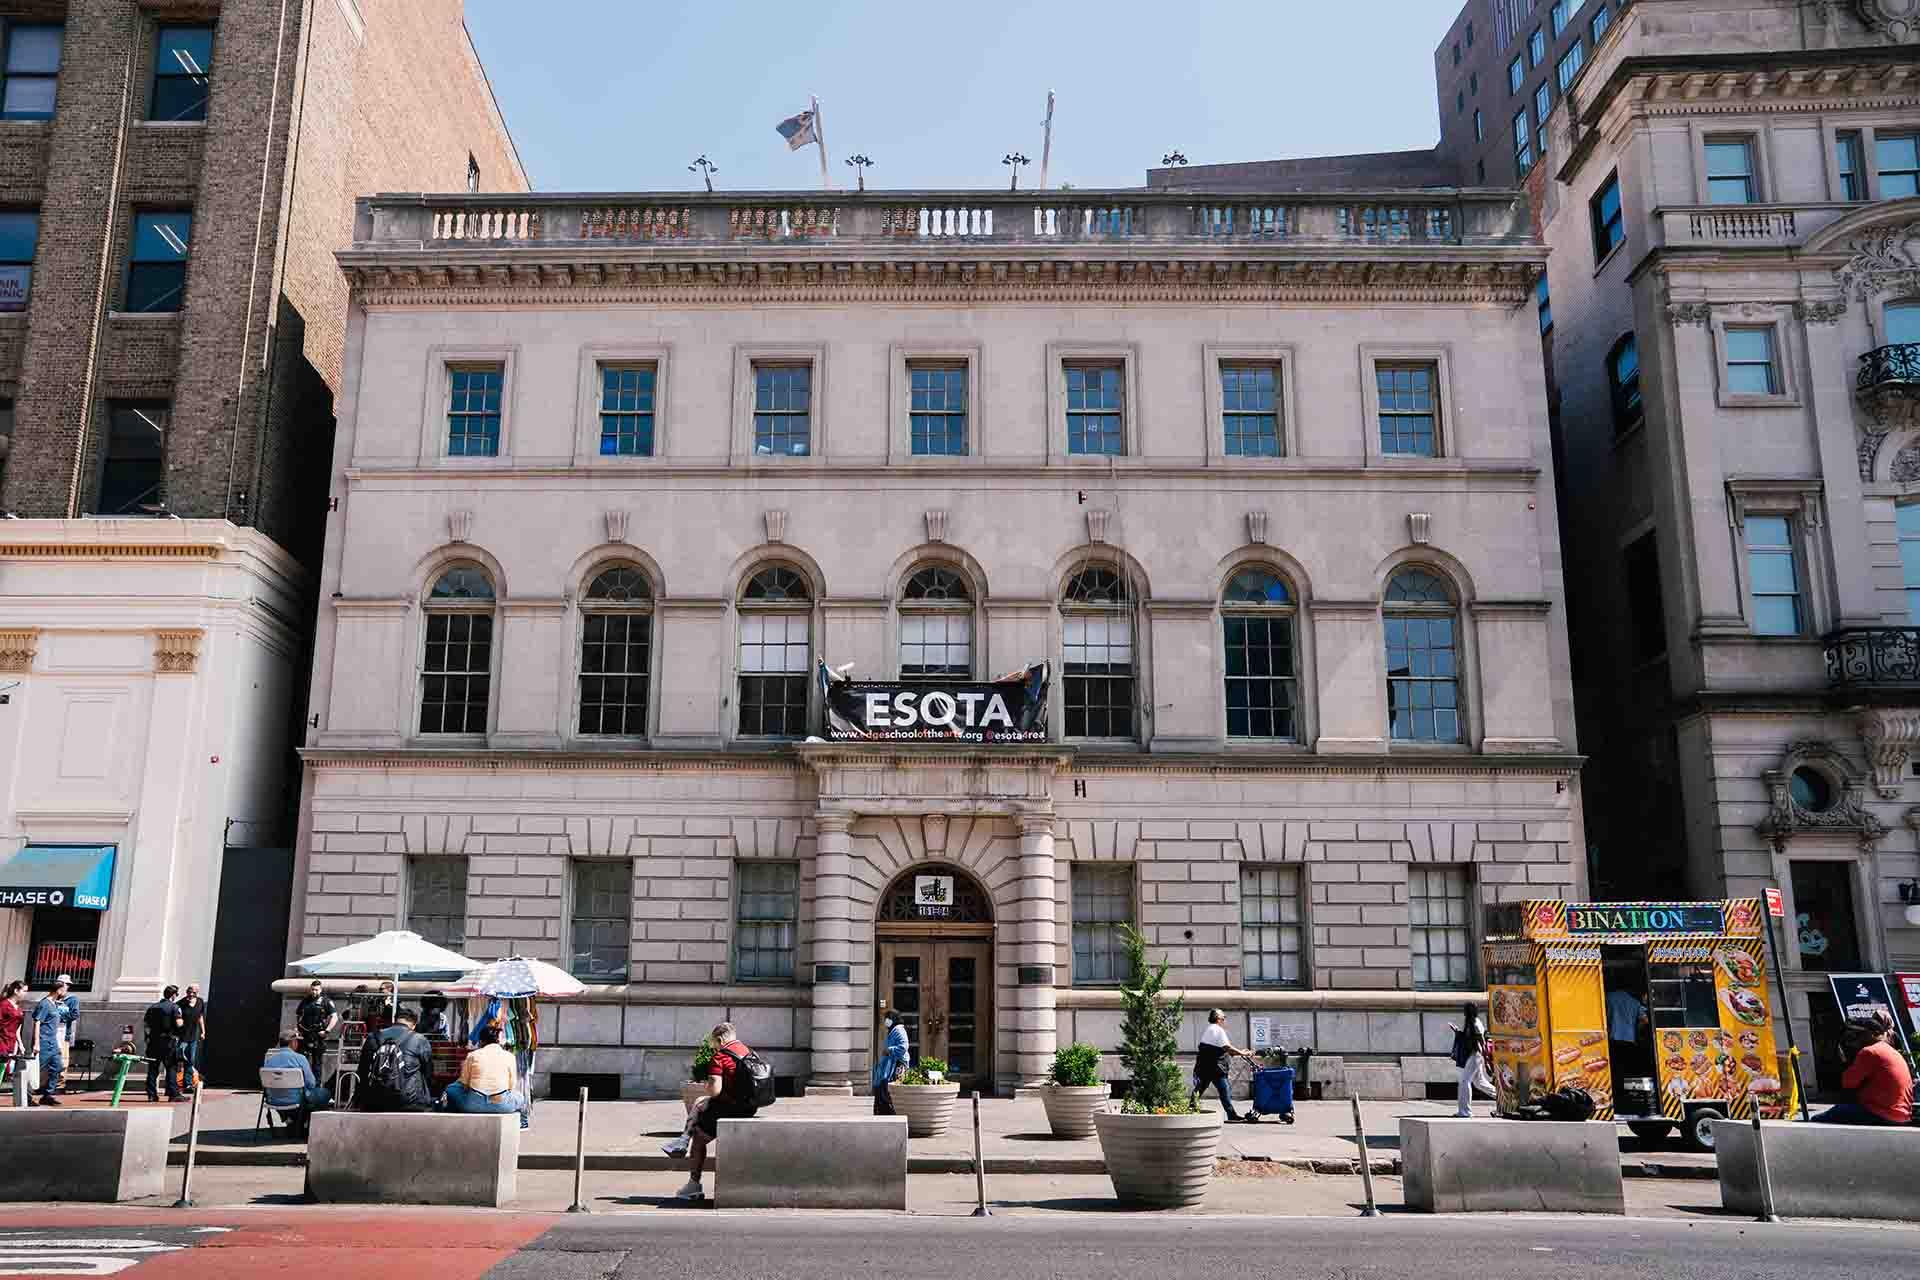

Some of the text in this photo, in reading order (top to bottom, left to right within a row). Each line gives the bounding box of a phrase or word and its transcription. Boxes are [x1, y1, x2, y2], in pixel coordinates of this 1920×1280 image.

[0, 892, 47, 904] HASE
[77, 895, 100, 906] CHASE
[1571, 910, 1685, 930] BINATION
